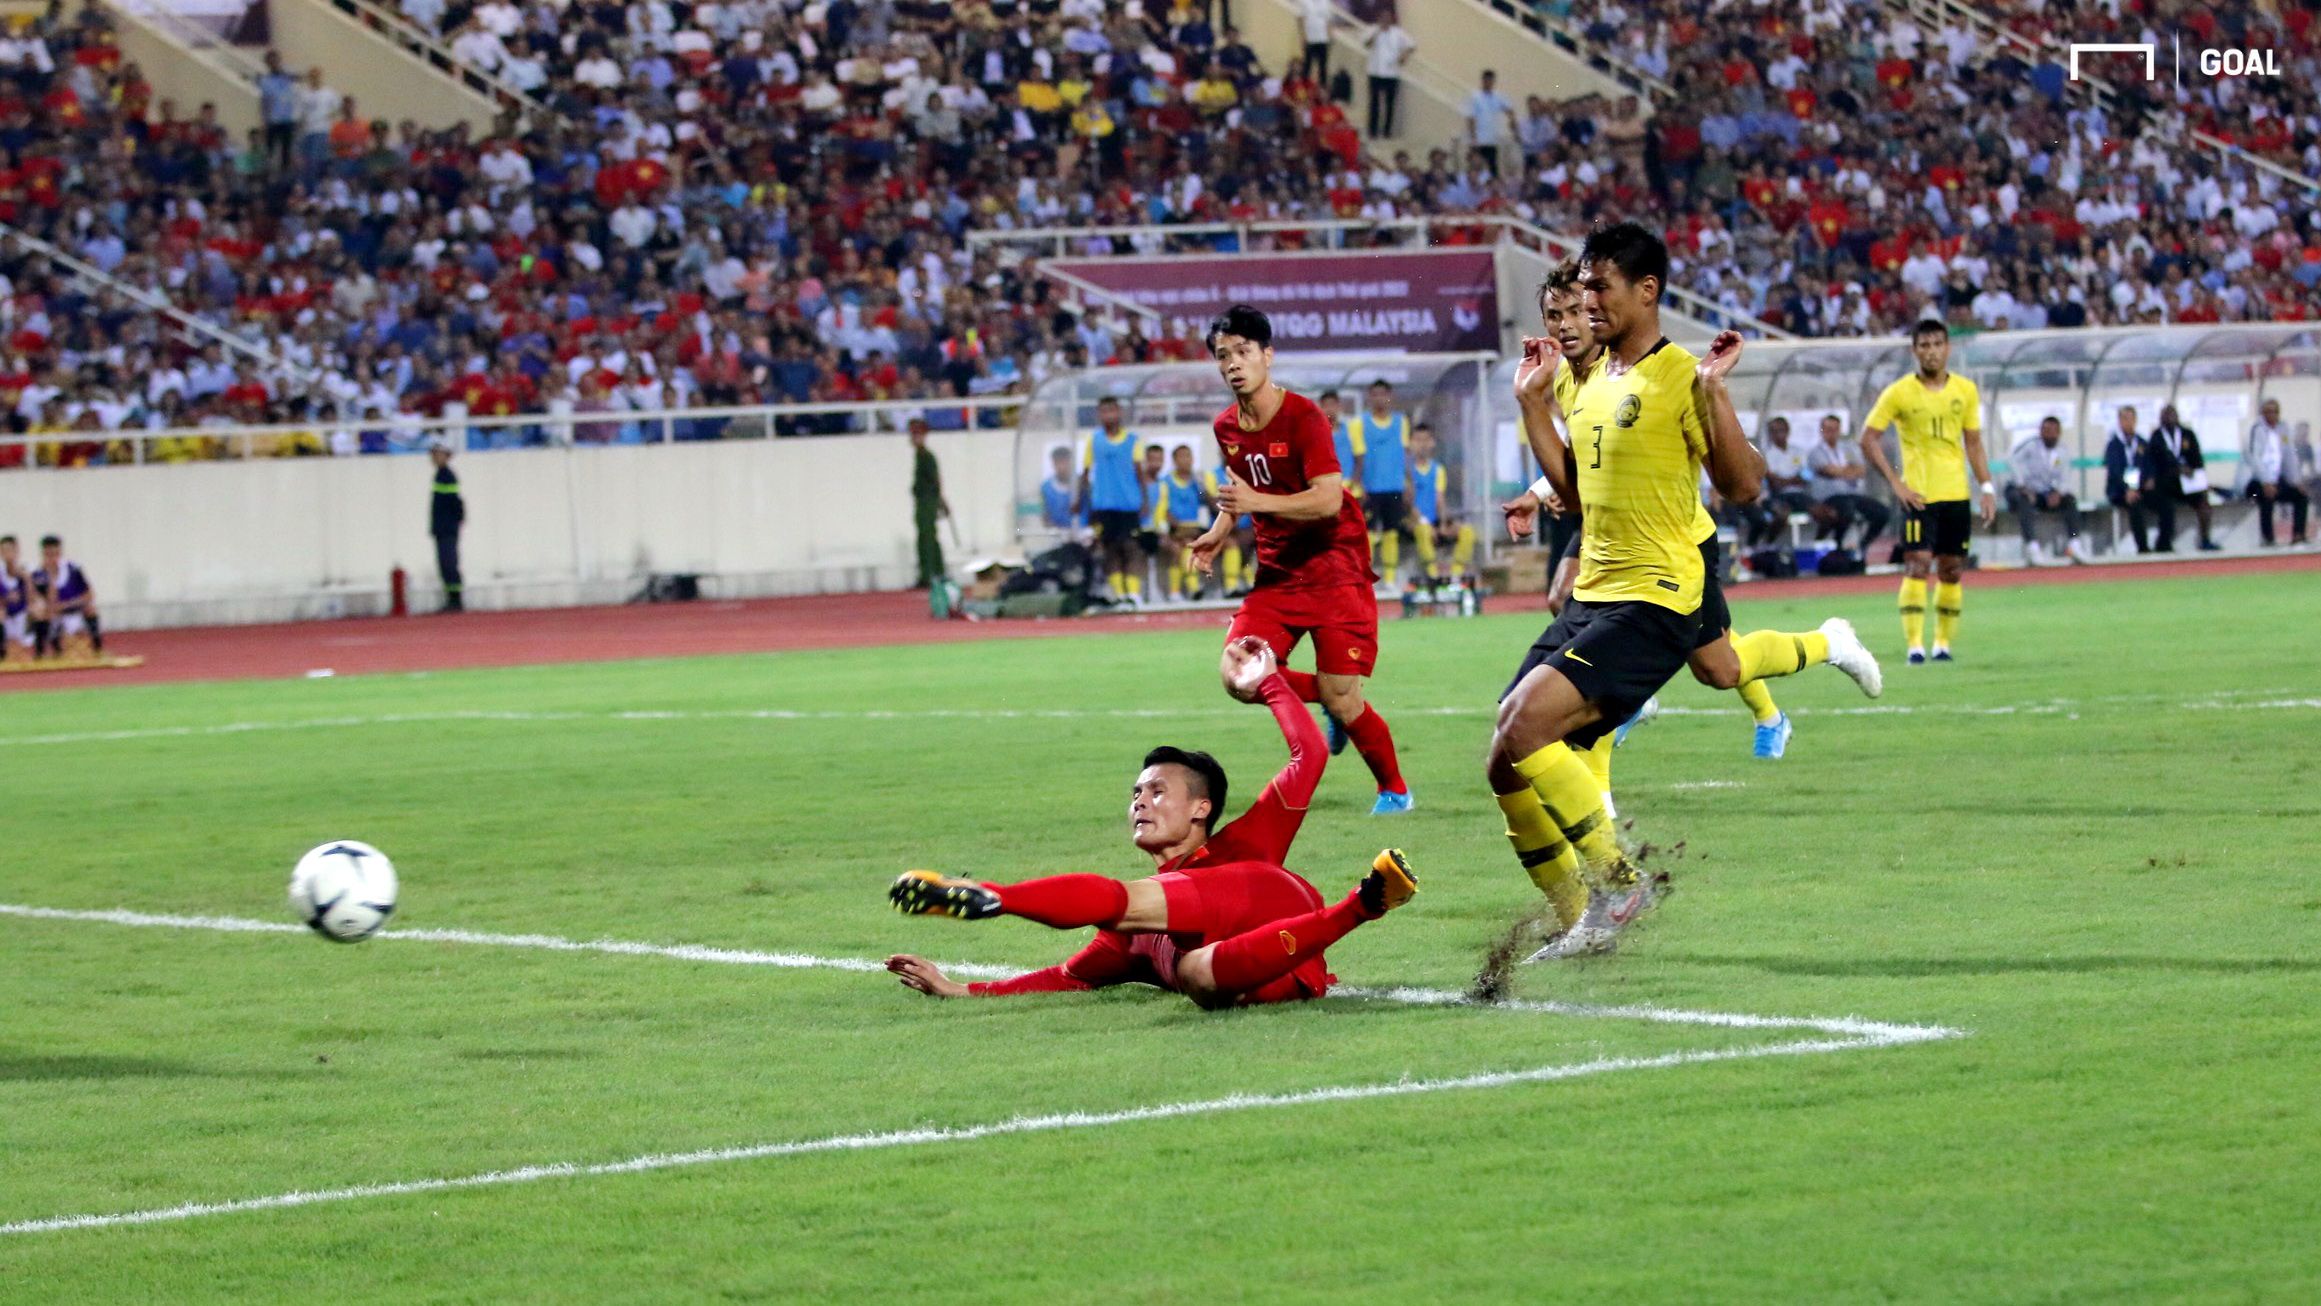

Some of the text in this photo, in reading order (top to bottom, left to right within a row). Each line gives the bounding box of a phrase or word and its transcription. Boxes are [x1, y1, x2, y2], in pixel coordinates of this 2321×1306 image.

[1327, 308, 1437, 336] MALAYSIA
[1931, 415, 1943, 439] 11
[1590, 425, 1603, 469] 3
[1245, 453, 1272, 487] 10
[1906, 518, 1921, 543] 11
